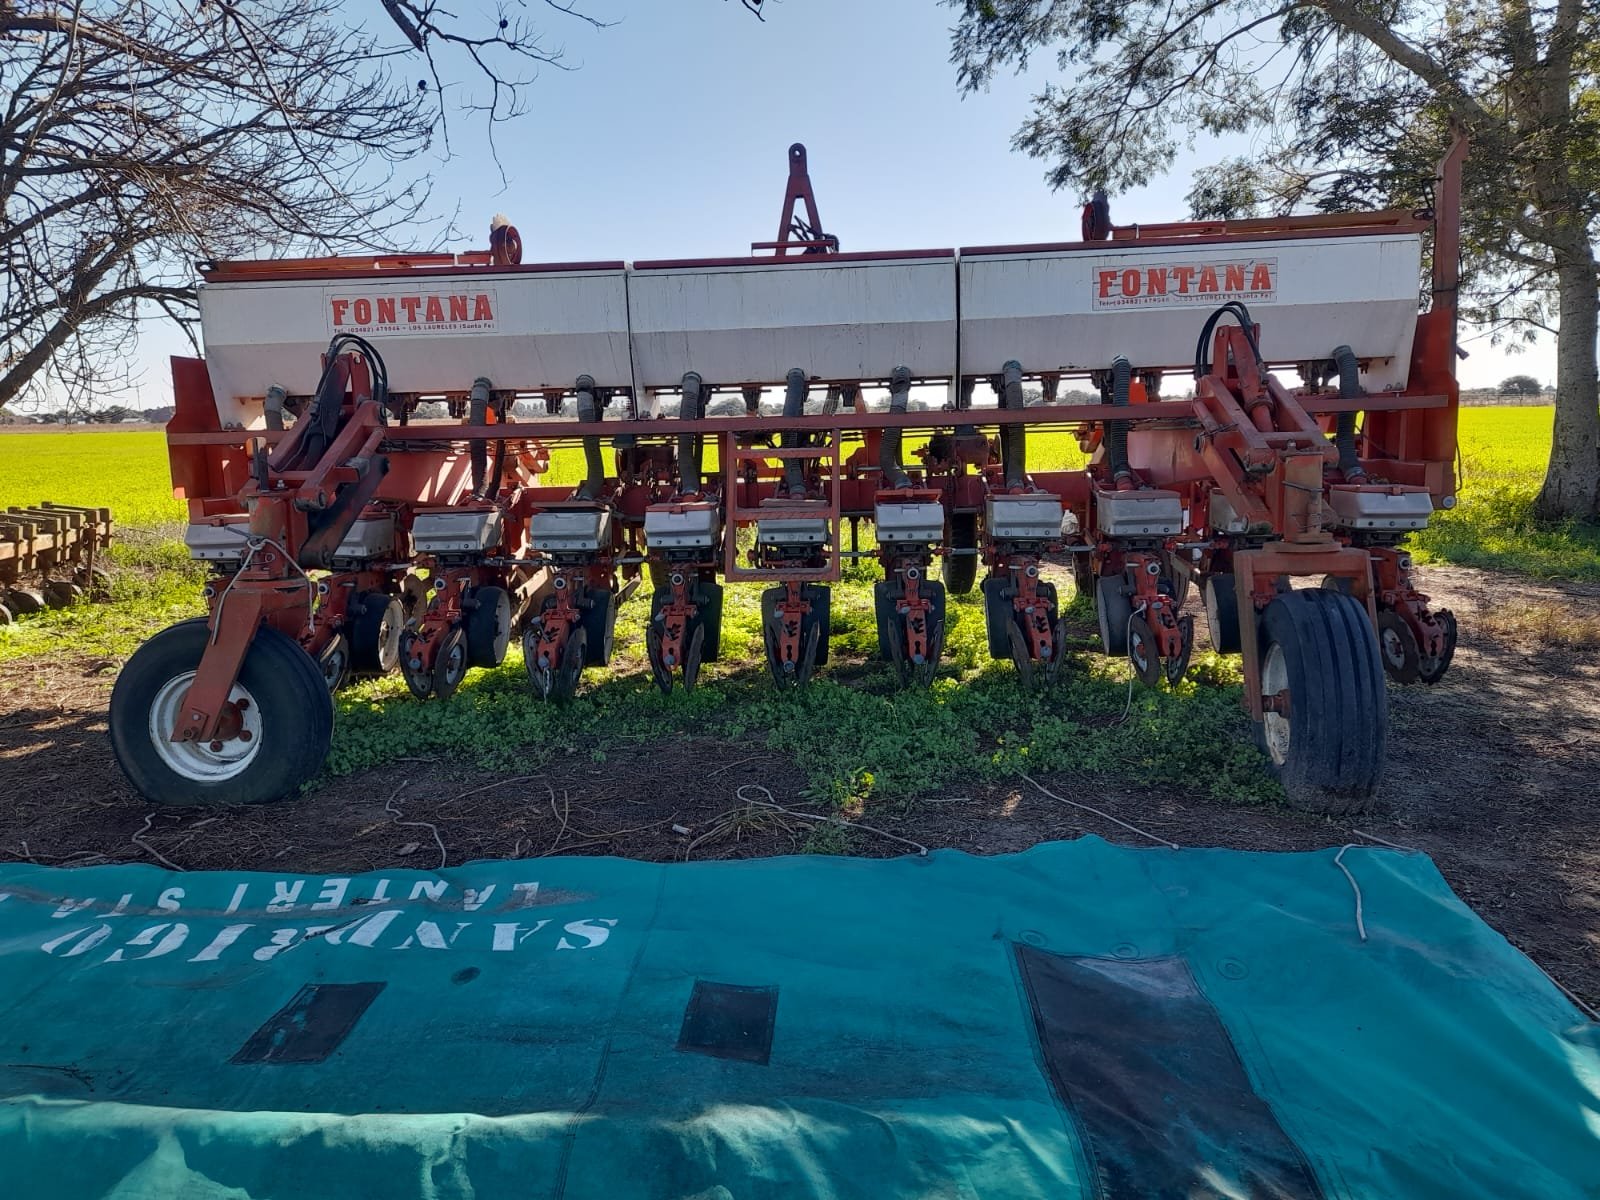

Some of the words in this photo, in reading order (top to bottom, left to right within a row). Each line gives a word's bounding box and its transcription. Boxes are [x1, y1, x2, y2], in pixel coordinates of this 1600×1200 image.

[1098, 263, 1272, 299] FONTANA
[332, 294, 494, 326] FONTANA
[40, 909, 619, 963] SANDRIGO
